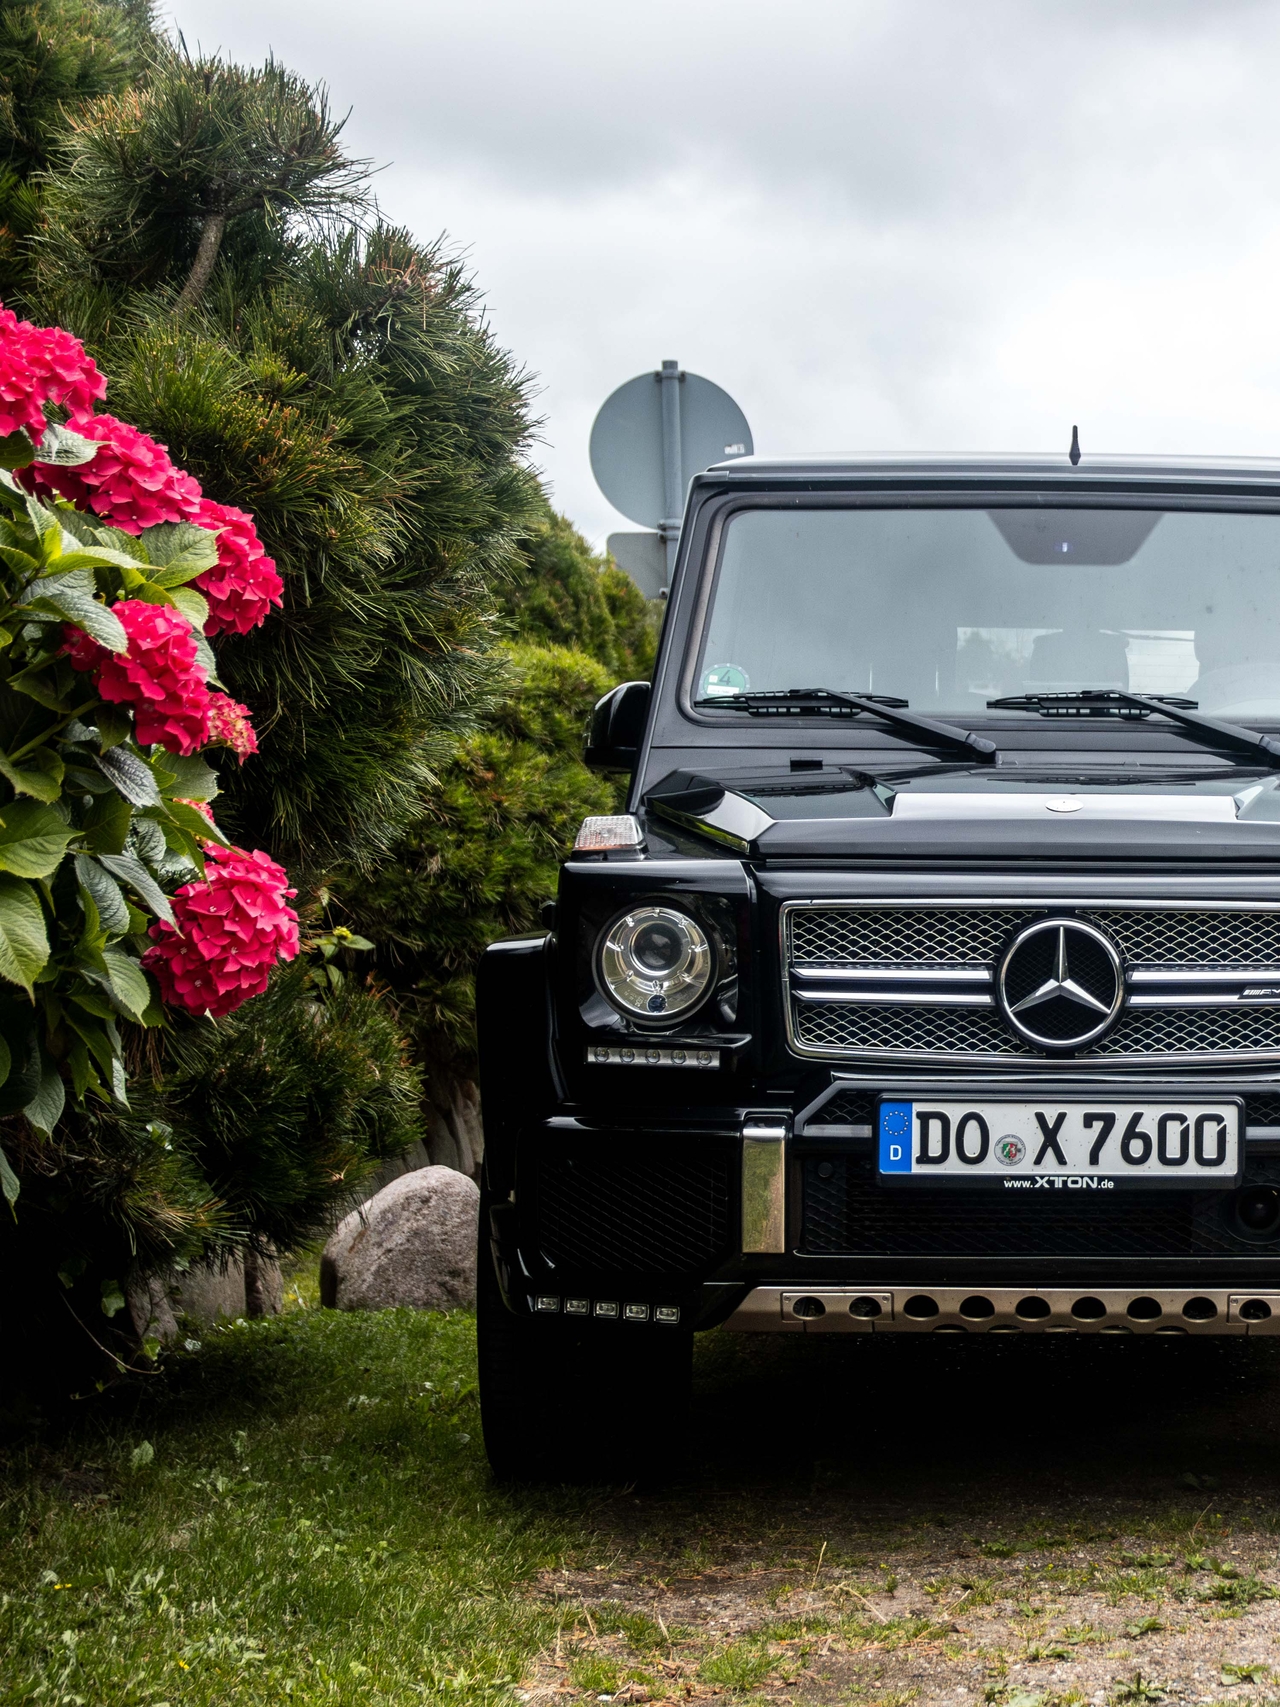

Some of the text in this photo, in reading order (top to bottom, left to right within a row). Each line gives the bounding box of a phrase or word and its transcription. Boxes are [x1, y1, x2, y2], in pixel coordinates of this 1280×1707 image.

[719, 669, 731, 685] 4
[915, 1110, 990, 1165] DO
[1033, 1111, 1068, 1166] X
[1083, 1111, 1227, 1167] 7600
[890, 1145, 902, 1161] D
[1003, 1176, 1115, 1189] www.XTON.de
